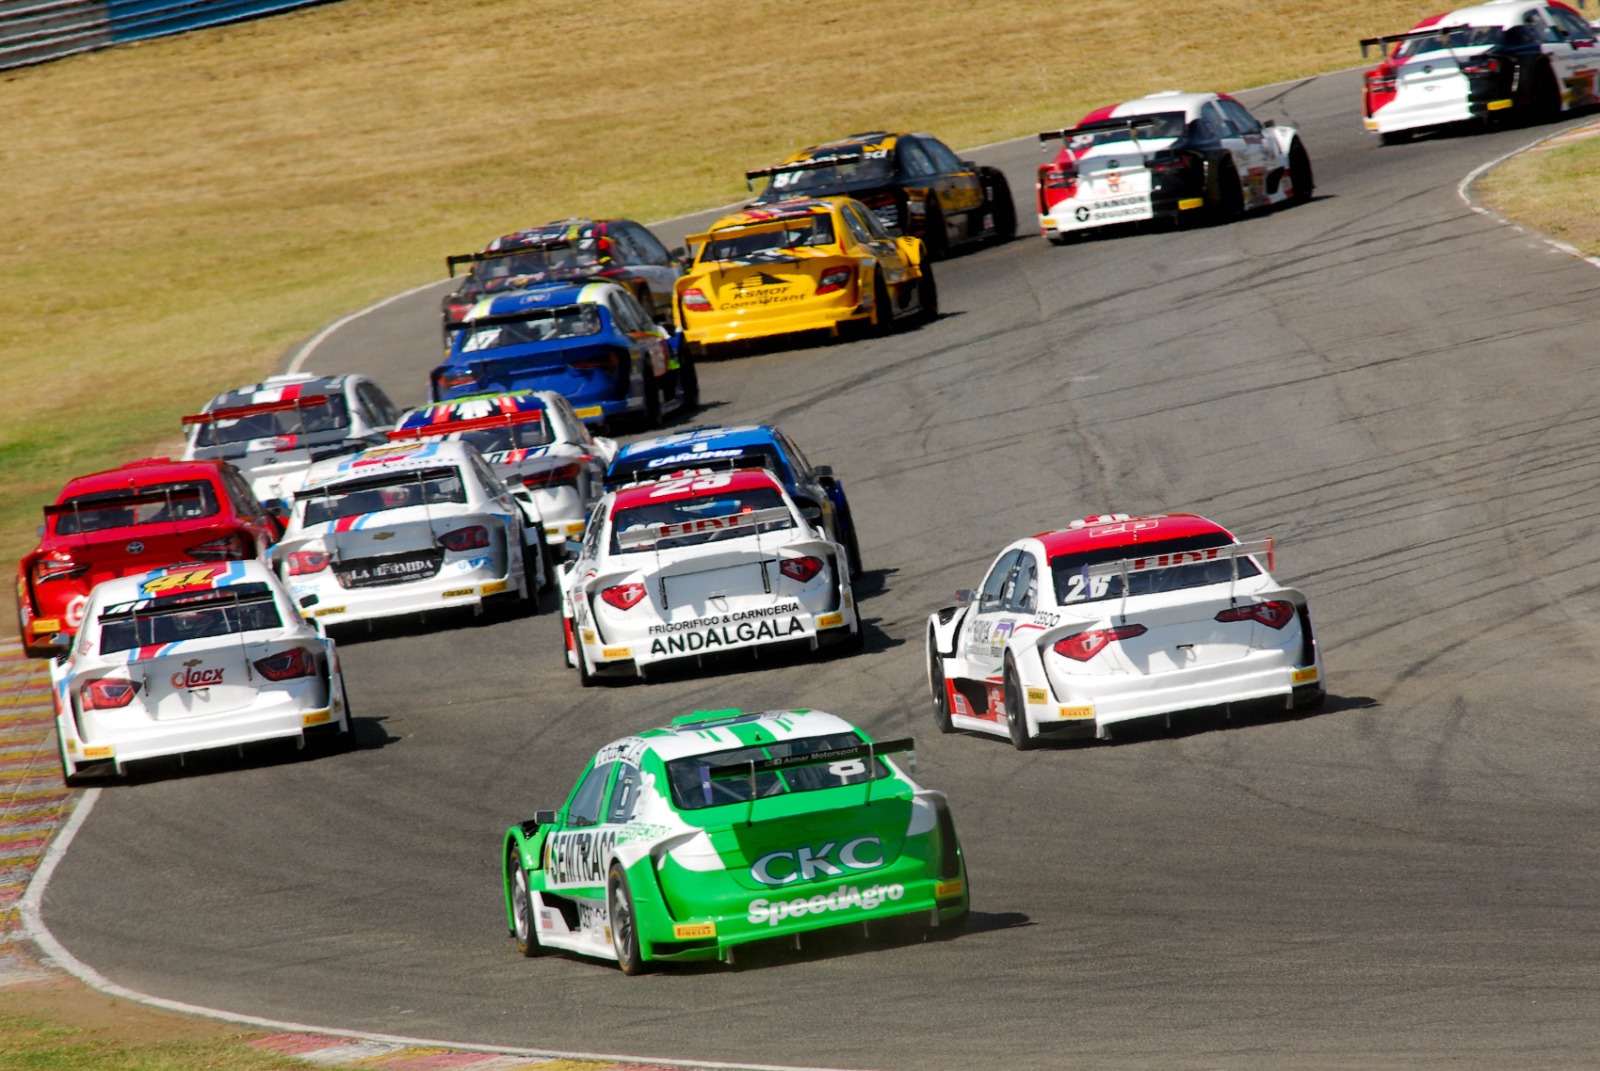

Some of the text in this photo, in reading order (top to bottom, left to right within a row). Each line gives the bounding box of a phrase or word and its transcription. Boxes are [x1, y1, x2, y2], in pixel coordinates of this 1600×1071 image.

[660, 514, 751, 537] FIAT
[648, 602, 800, 635] FRIGORIFICO & CARNICERIA
[651, 616, 805, 656] ANDALGALA
[811, 747, 859, 760] Motorsport
[750, 836, 884, 885] CKC
[747, 883, 905, 927] SpeedAgro
[676, 926, 712, 938] PIRELLI
